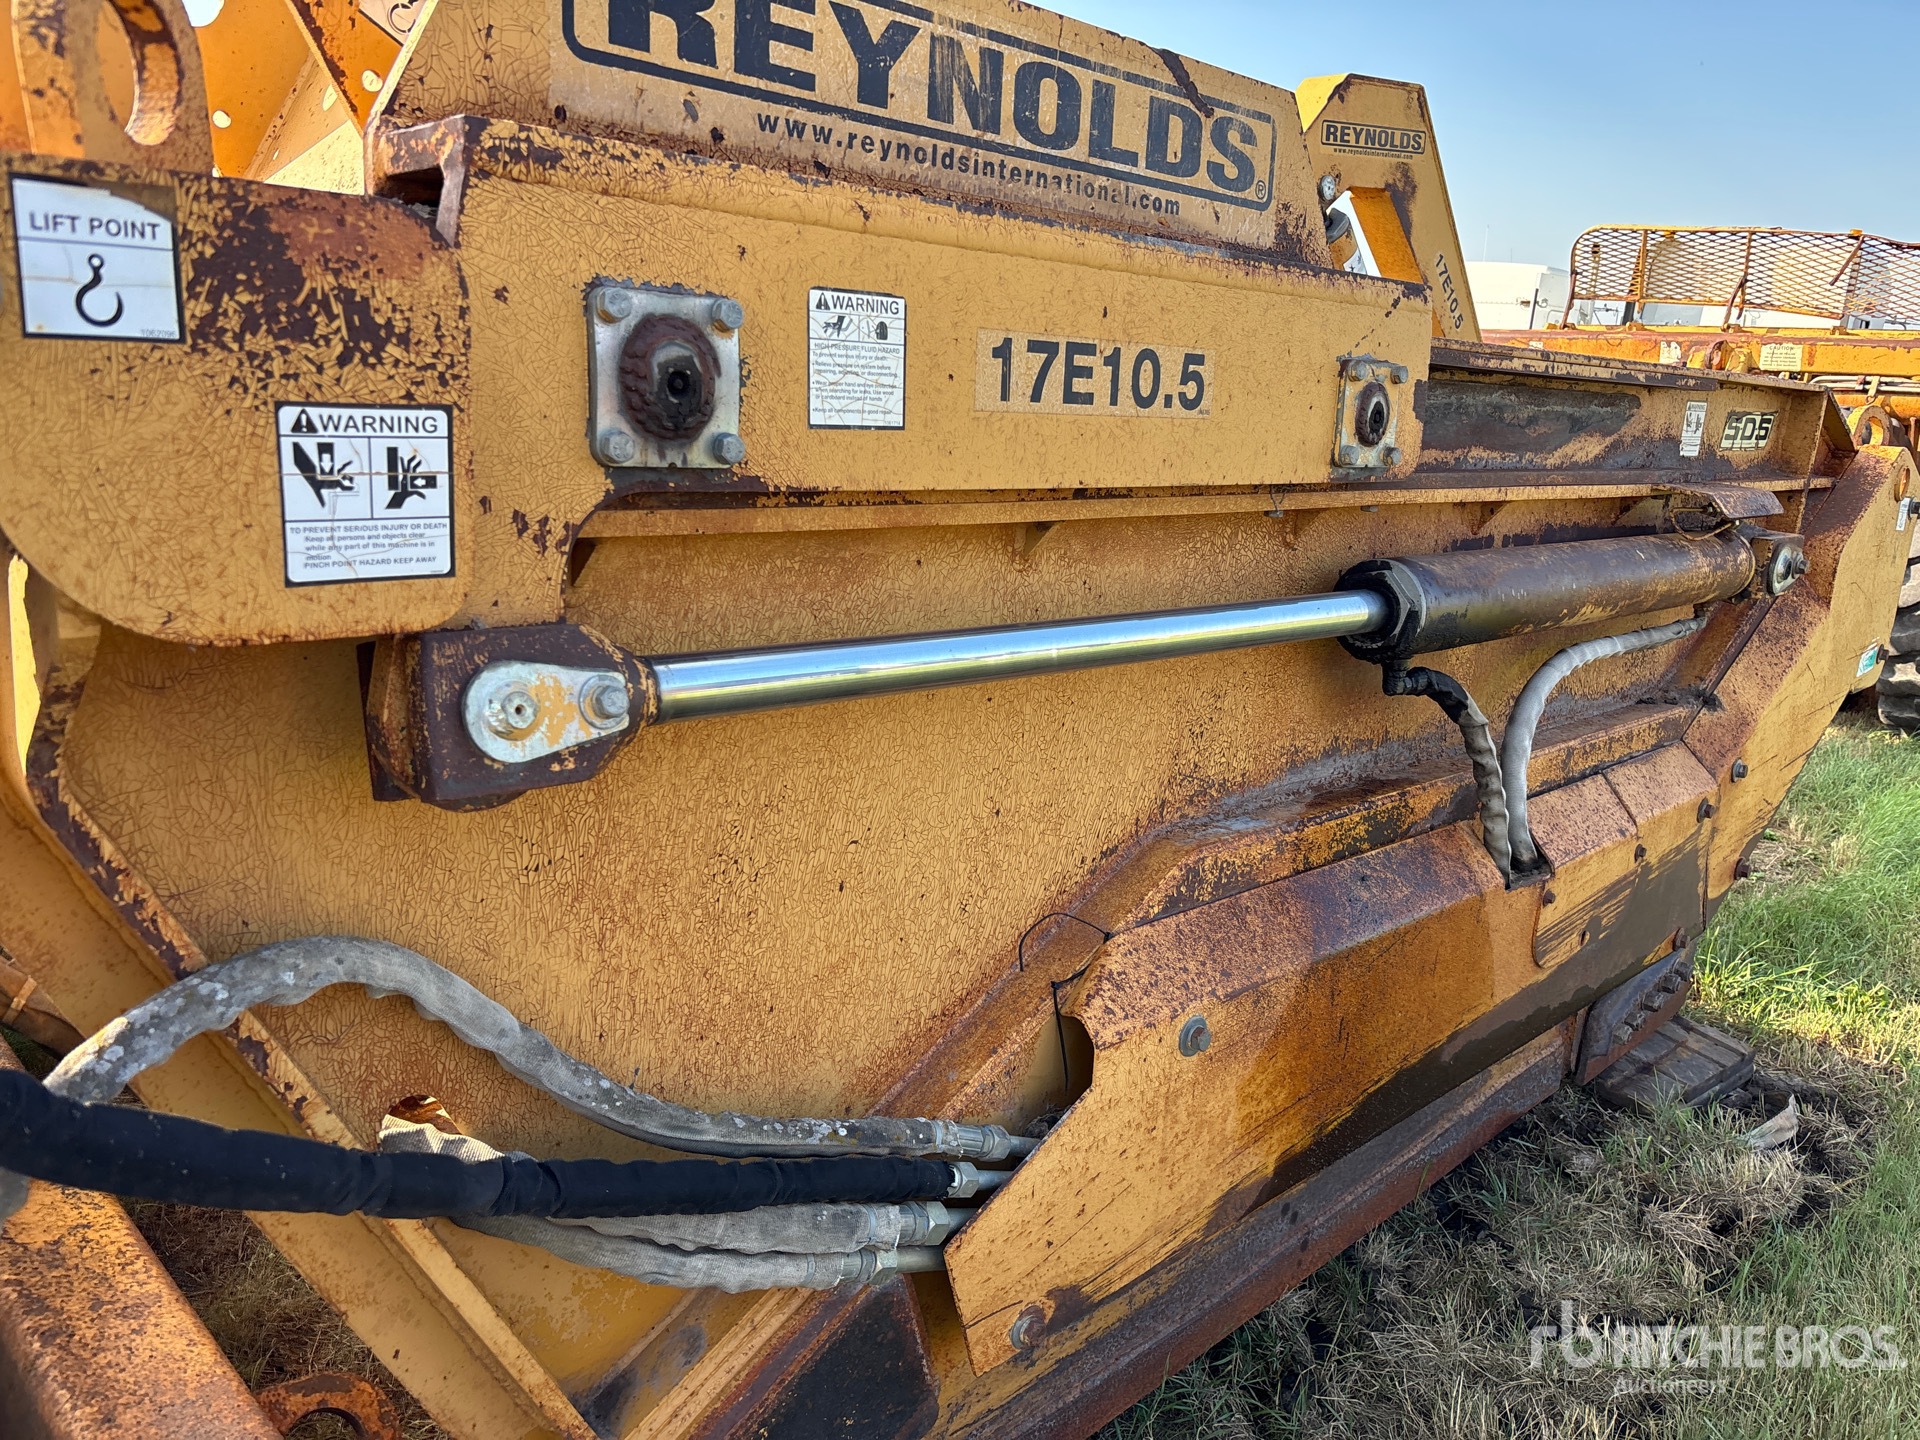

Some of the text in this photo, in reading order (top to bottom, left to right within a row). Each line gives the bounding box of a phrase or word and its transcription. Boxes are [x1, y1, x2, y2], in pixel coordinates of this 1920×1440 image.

[1325, 124, 1422, 151] REYNOLDS
[757, 112, 1181, 216] www.reynoldsinternational.com
[1333, 147, 1413, 160] www.reynoldsinternational.com
[29, 211, 161, 241] LIFT POINT
[1435, 253, 1464, 329] 17E10.5
[831, 294, 900, 315] WARNING
[861, 345, 877, 353] FLUID
[991, 337, 1206, 411] 17E10.5
[318, 413, 438, 434] WARNING
[303, 525, 341, 534] PREVENT
[343, 524, 379, 533] SERIOUS
[380, 523, 409, 531] INJURY
[424, 522, 448, 530] DEATH
[304, 535, 325, 543] Keep
[337, 535, 366, 543] persons
[367, 533, 381, 541] and
[381, 532, 407, 541] objects
[328, 544, 343, 552] any
[344, 543, 361, 551] part
[361, 542, 370, 550] of
[387, 541, 419, 549] machine
[304, 561, 331, 569] PINCH
[332, 560, 357, 568] POINT
[359, 558, 392, 566] HAZARD
[393, 557, 414, 565] KEEP
